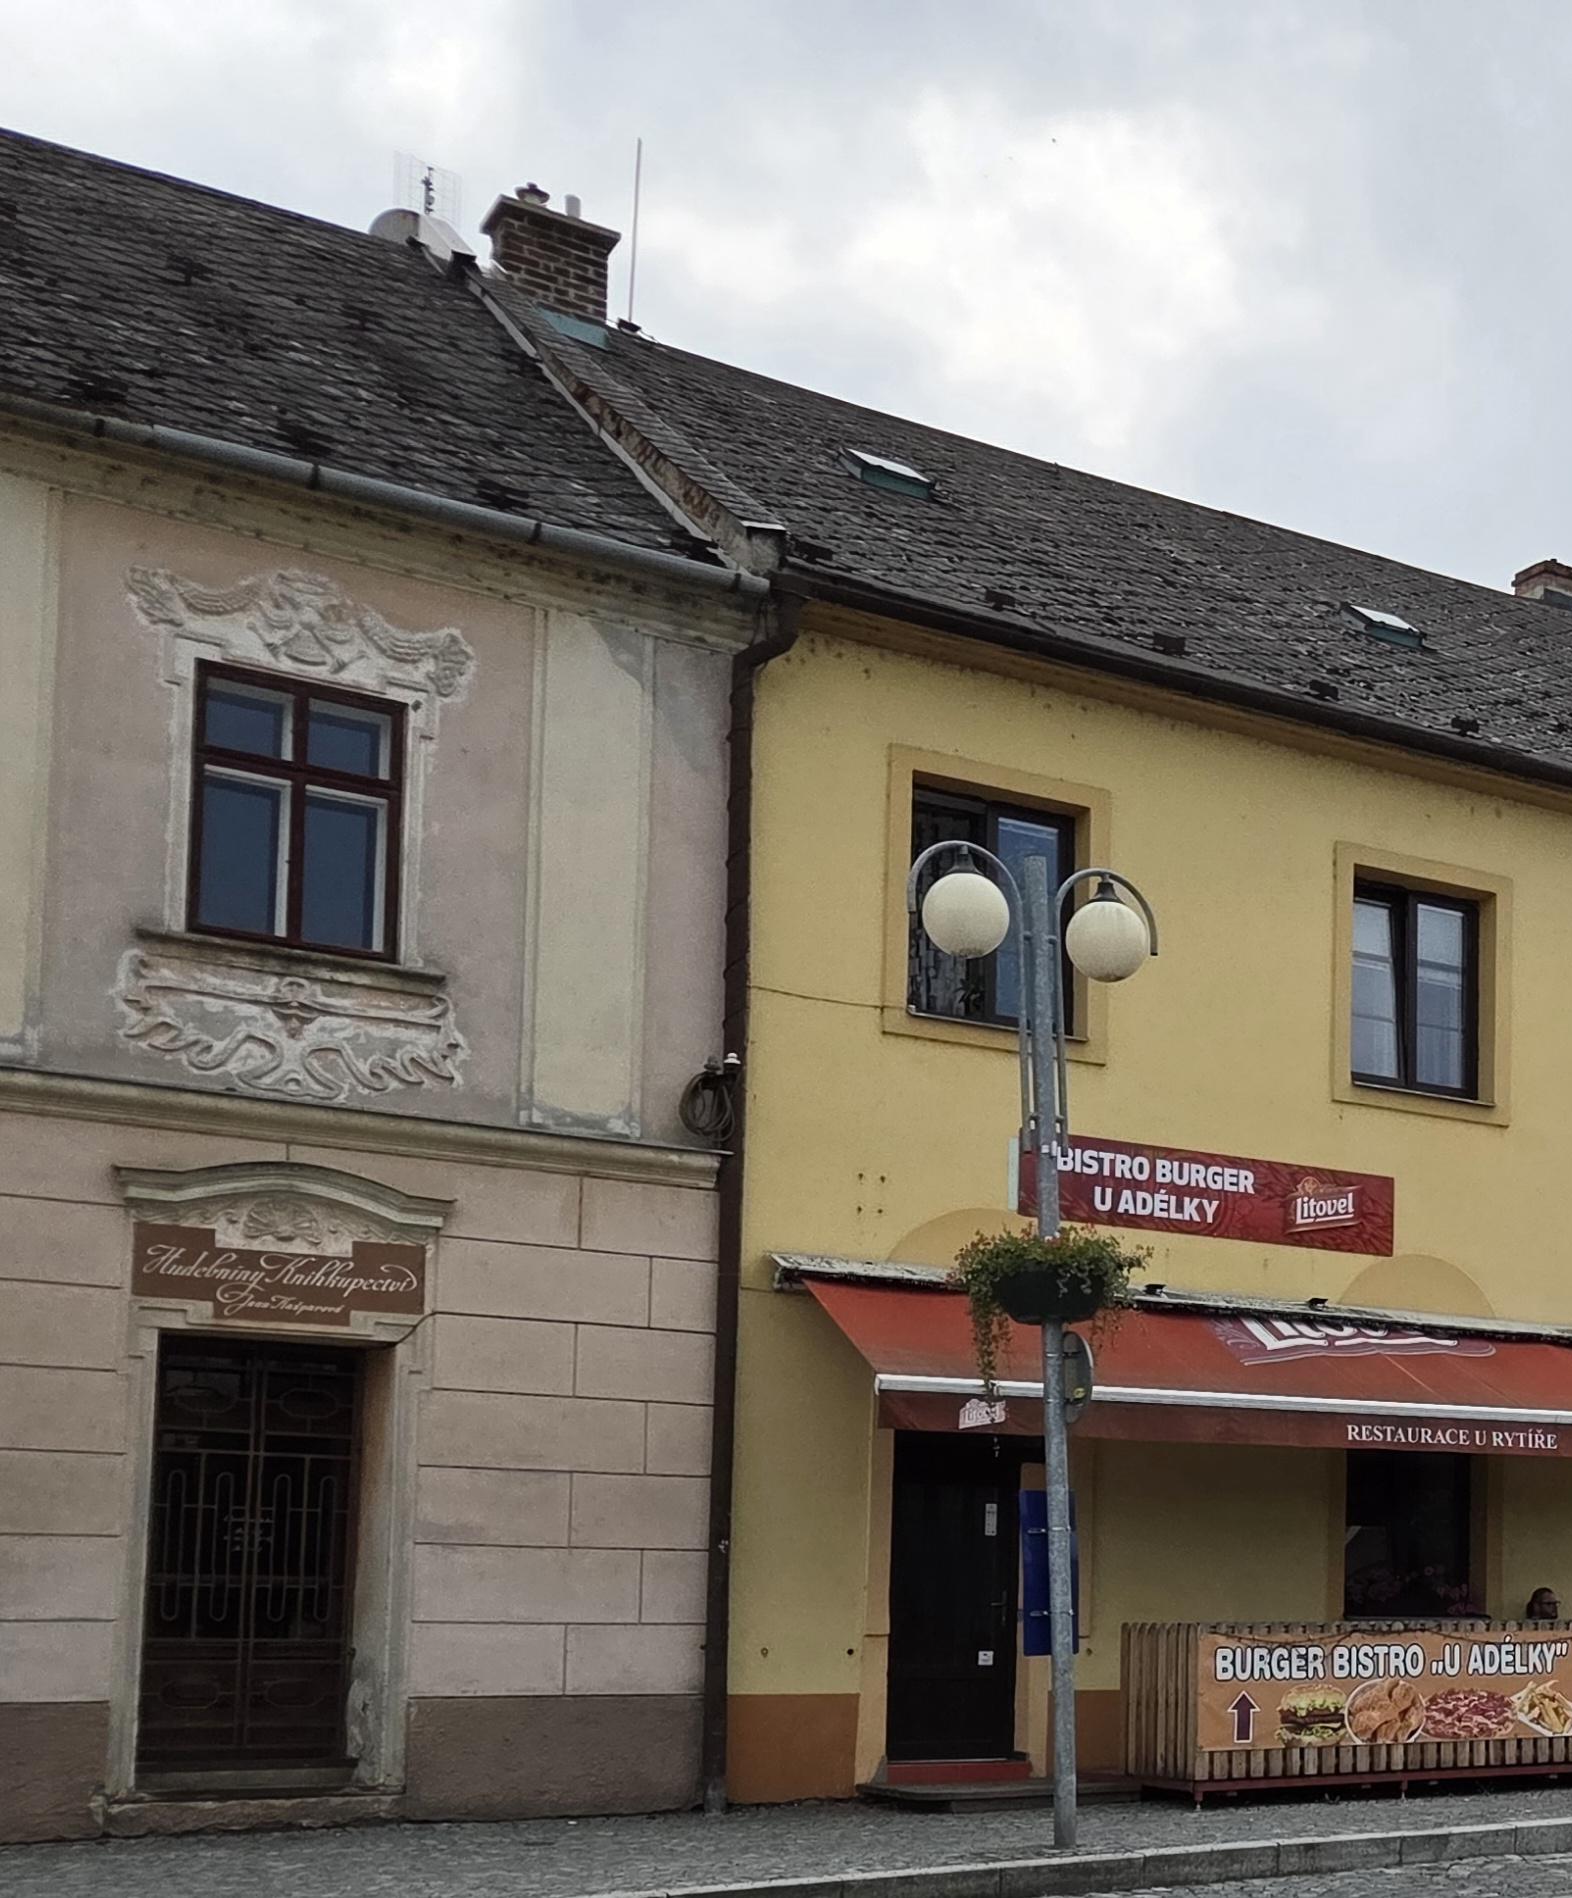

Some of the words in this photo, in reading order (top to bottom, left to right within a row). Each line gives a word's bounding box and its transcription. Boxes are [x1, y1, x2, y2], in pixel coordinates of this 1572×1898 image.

[1056, 1145, 1151, 1181] BISTRO
[1155, 1158, 1256, 1194] BURGER
[1093, 1186, 1113, 1212] U
[1117, 1188, 1220, 1224] ADÉLKY
[1295, 1192, 1355, 1225] Litovel
[143, 1244, 267, 1291] Hudebniny
[259, 1253, 418, 1299] Knihkupectví
[1346, 1423, 1471, 1446] RESTAURACE
[1474, 1428, 1487, 1446] U
[1492, 1428, 1558, 1450] RYTÍŘE
[1214, 1645, 1325, 1681] BURGER
[1332, 1642, 1426, 1680] BISTRO
